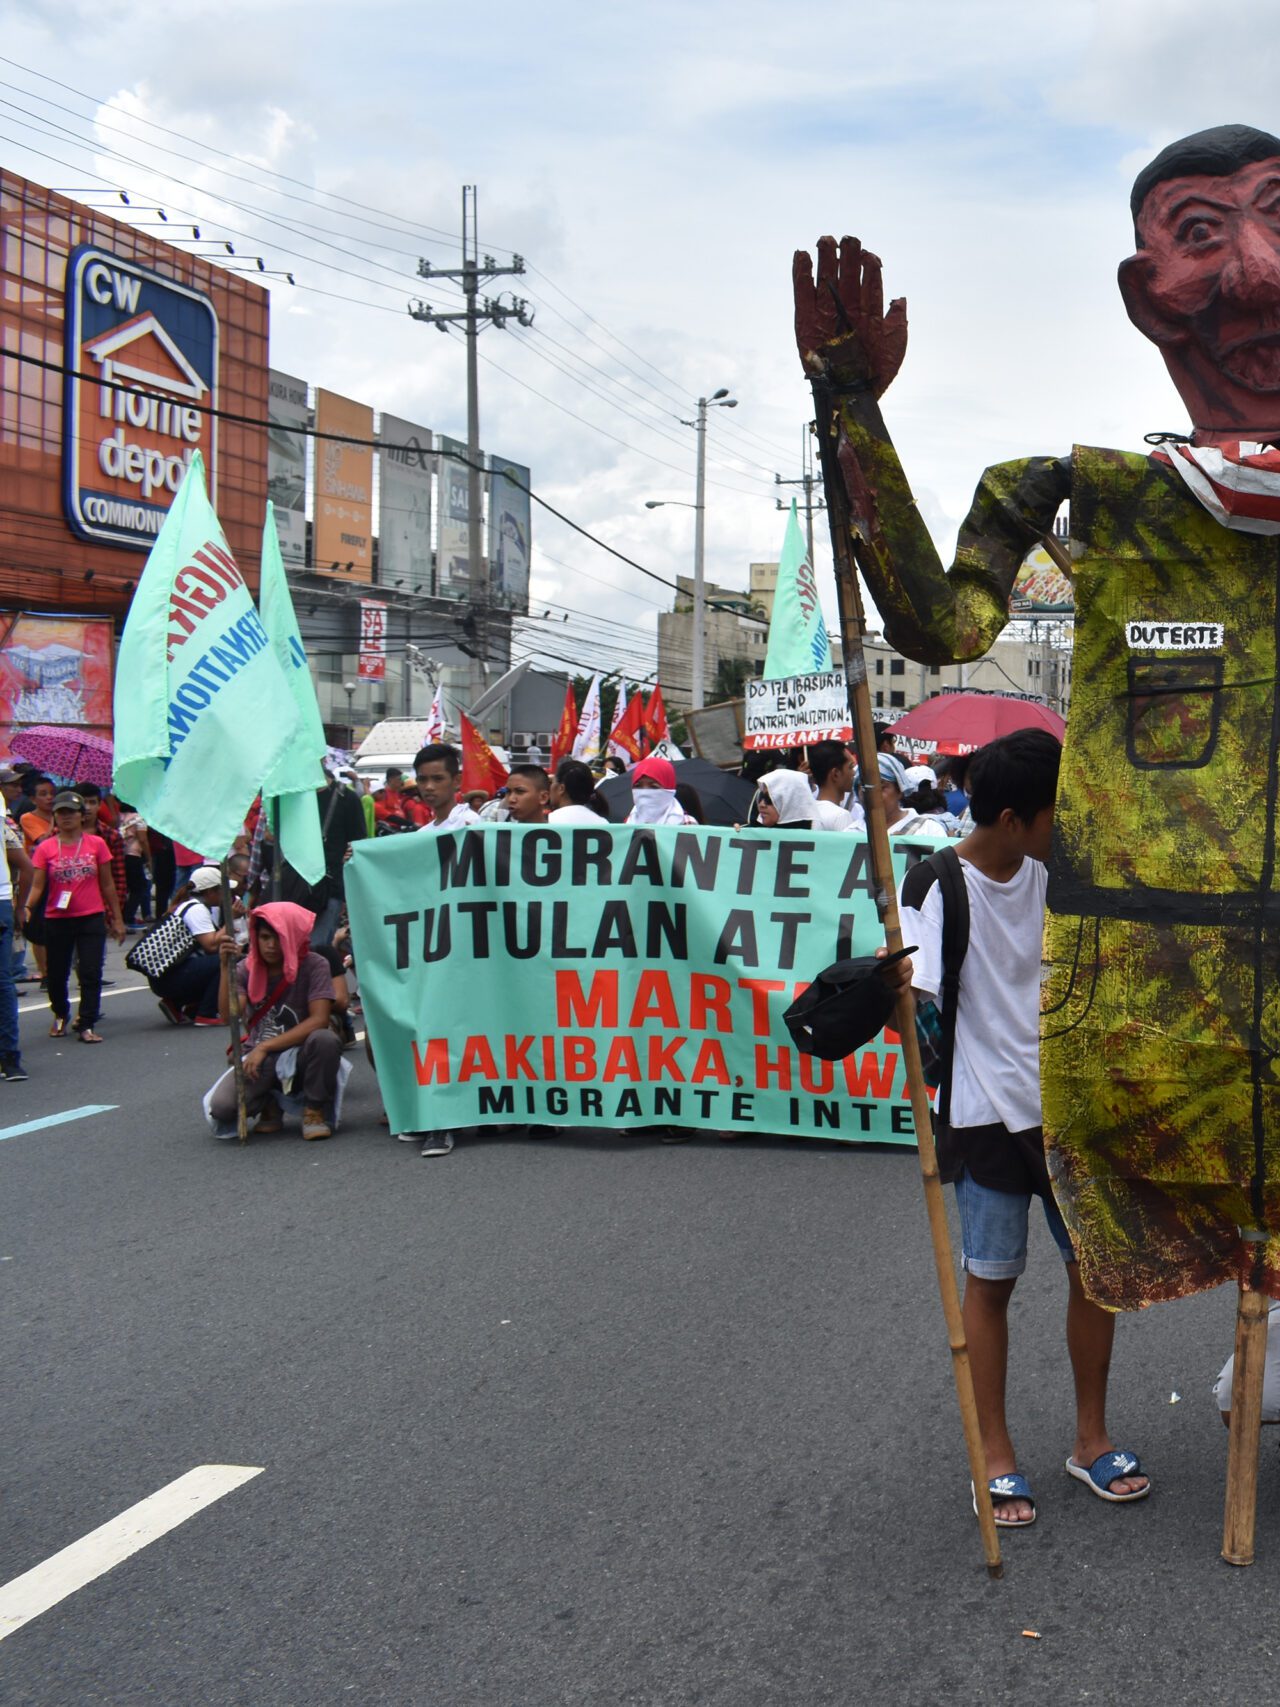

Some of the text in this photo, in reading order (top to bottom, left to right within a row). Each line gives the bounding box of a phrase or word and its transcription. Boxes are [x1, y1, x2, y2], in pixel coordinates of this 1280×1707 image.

[85, 263, 142, 314] CW
[100, 359, 203, 443] home
[98, 427, 197, 498] depo
[1130, 625, 1218, 645] DUTERTE
[749, 684, 767, 698] DO
[777, 694, 806, 712] END
[753, 729, 843, 748] MIGRANTE
[436, 828, 815, 898] MIGRANTE
[384, 901, 688, 970] TUTULAN
[714, 909, 811, 969] AT
[479, 1085, 755, 1122] MIGRANTE
